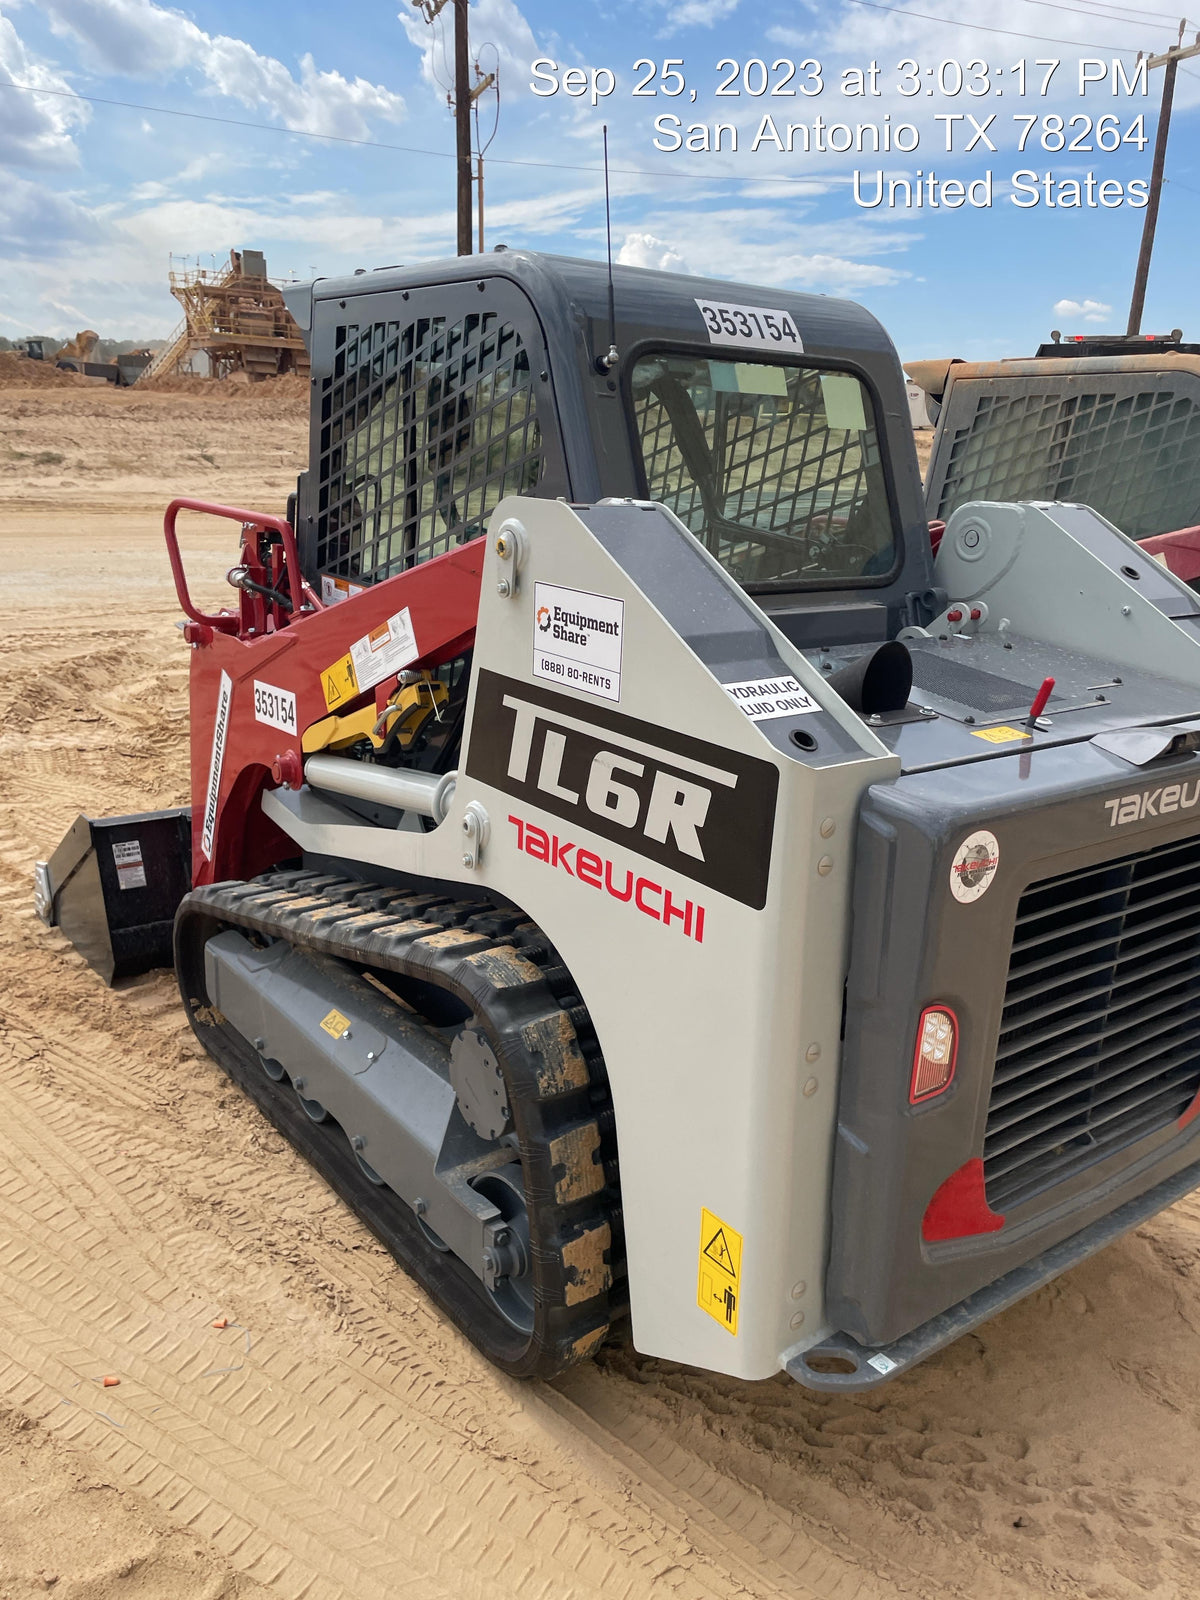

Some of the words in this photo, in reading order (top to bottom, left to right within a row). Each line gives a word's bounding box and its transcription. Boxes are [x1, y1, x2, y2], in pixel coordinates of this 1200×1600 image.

[702, 306, 797, 343] 353154
[553, 606, 619, 636] Equipment
[553, 624, 588, 646] Share
[541, 658, 565, 676] (888)
[567, 667, 611, 690] 80-RENTS
[255, 688, 295, 727] 353154
[776, 696, 812, 711] ONLY
[205, 692, 229, 836] EquipmentShare
[502, 694, 738, 863] TL6R
[508, 814, 705, 943] TAKEUCHI
